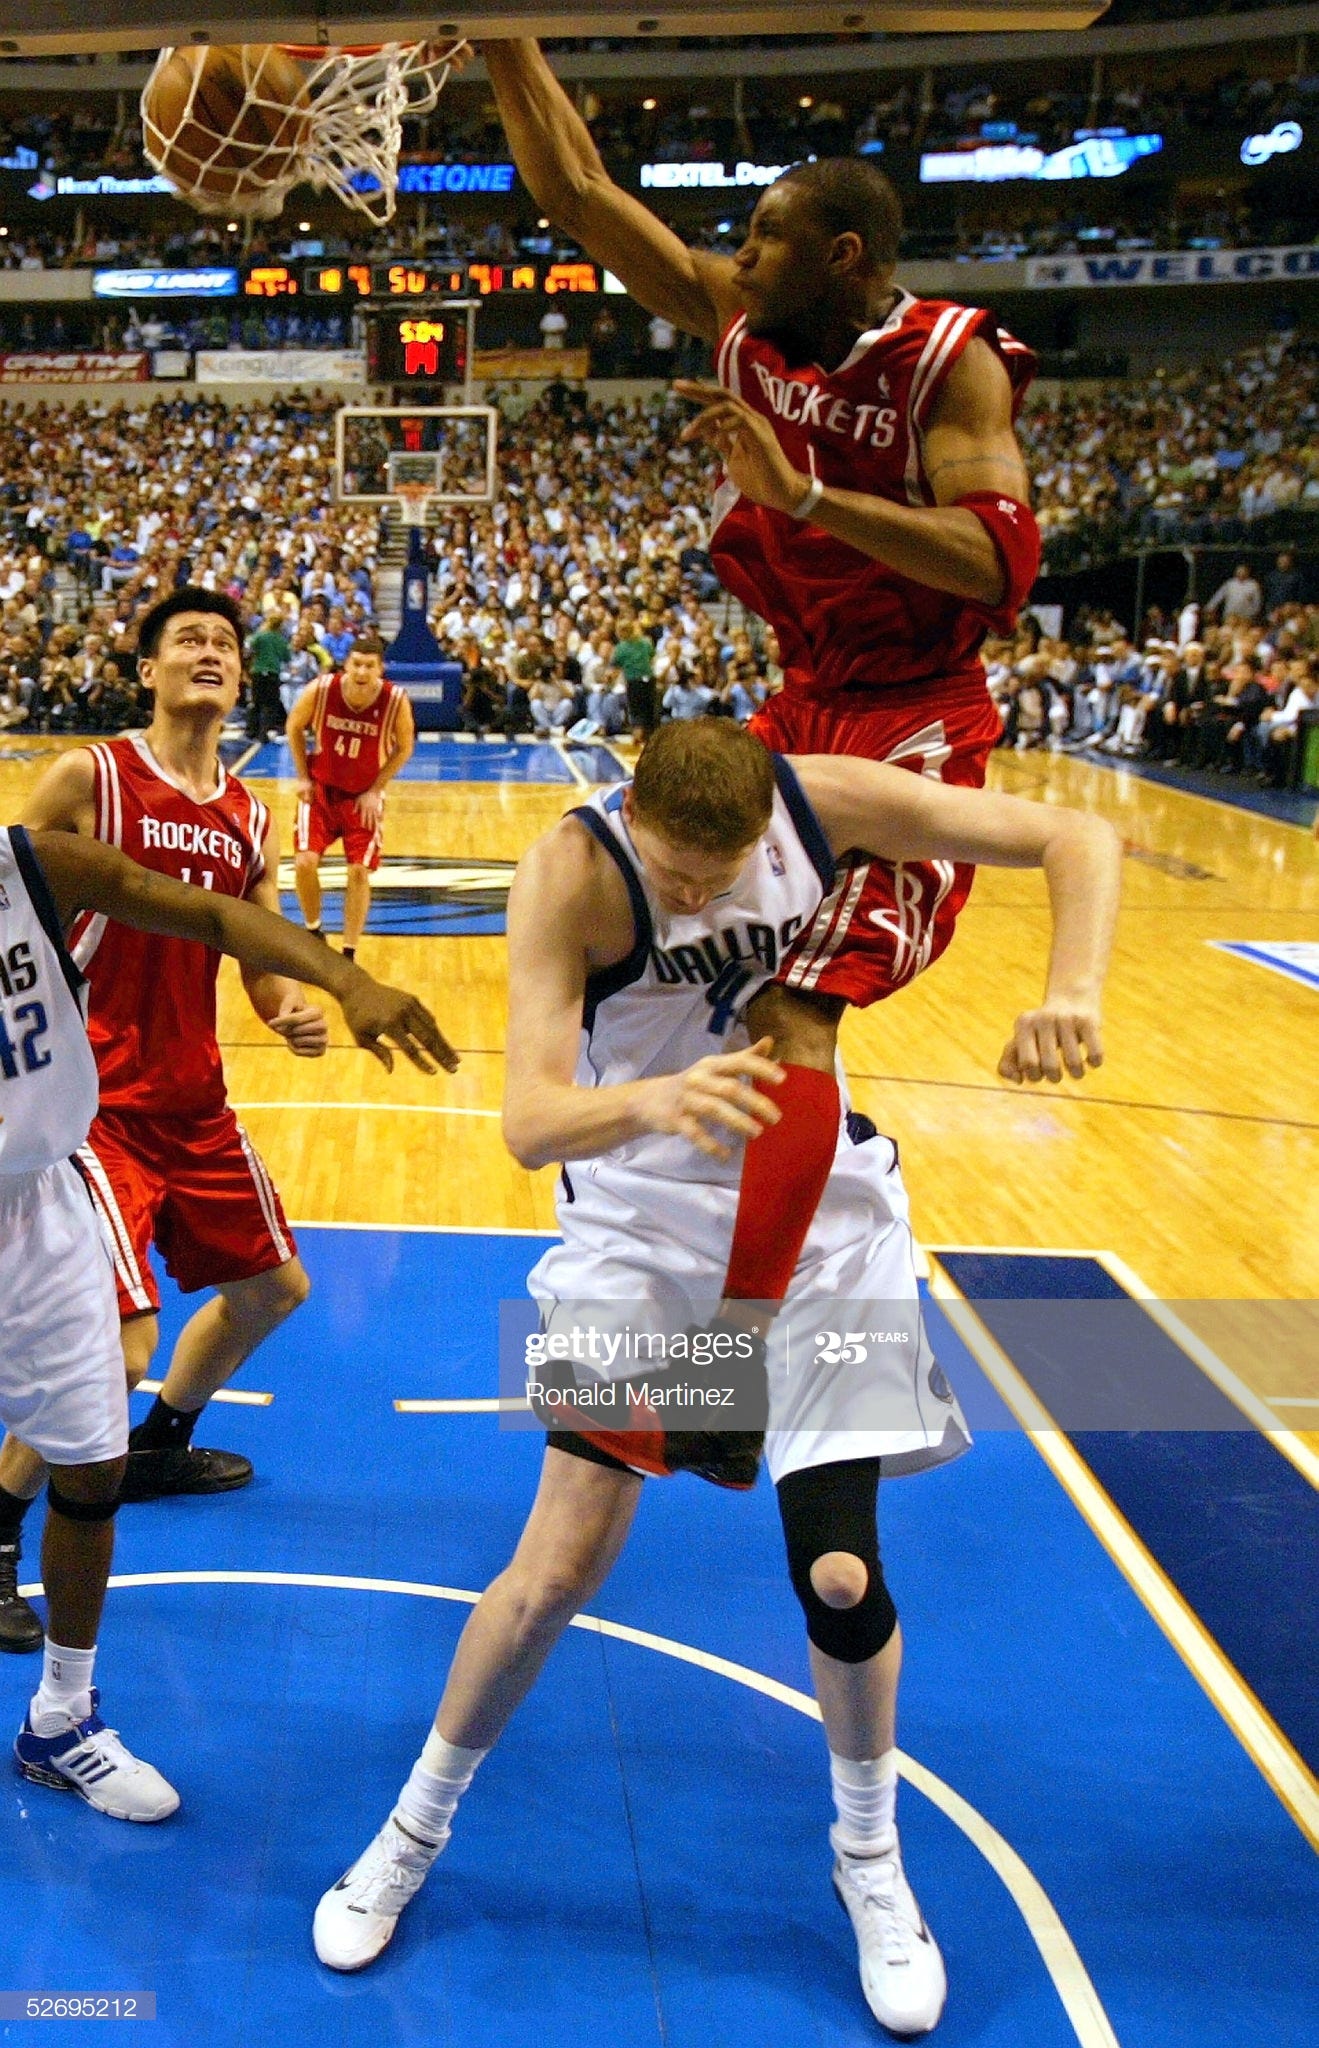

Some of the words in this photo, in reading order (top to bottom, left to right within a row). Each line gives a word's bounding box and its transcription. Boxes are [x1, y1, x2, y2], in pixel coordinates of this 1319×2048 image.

[752, 361, 898, 448] ROCKETS
[327, 714, 379, 737] ROCKETS
[137, 814, 242, 869] ROCKETS
